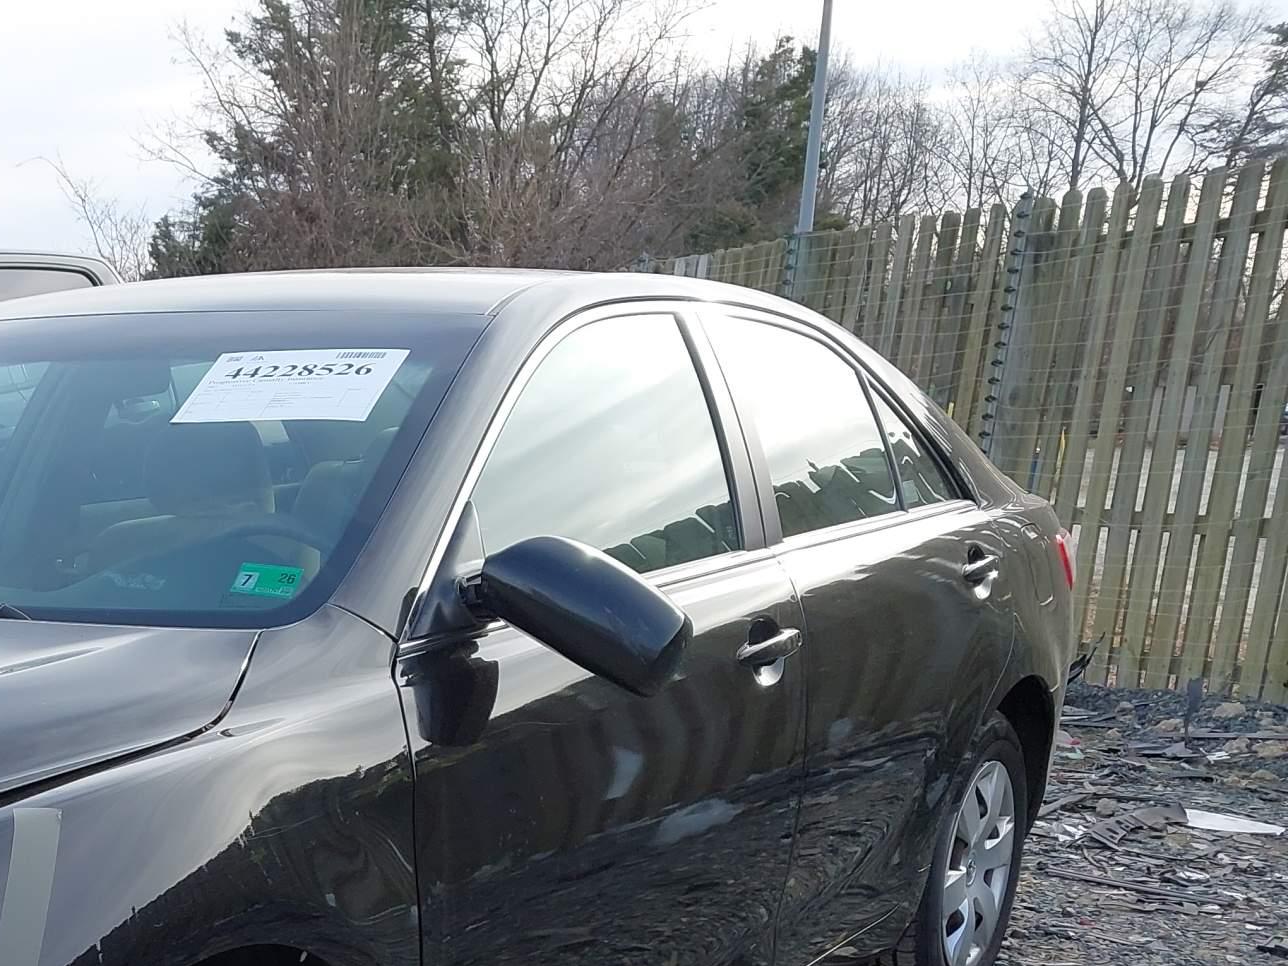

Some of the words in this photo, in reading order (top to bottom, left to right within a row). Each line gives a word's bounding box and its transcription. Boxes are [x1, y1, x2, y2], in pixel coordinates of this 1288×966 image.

[225, 362, 377, 380] 44228526
[241, 573, 254, 586] 7
[278, 572, 296, 585] 26
